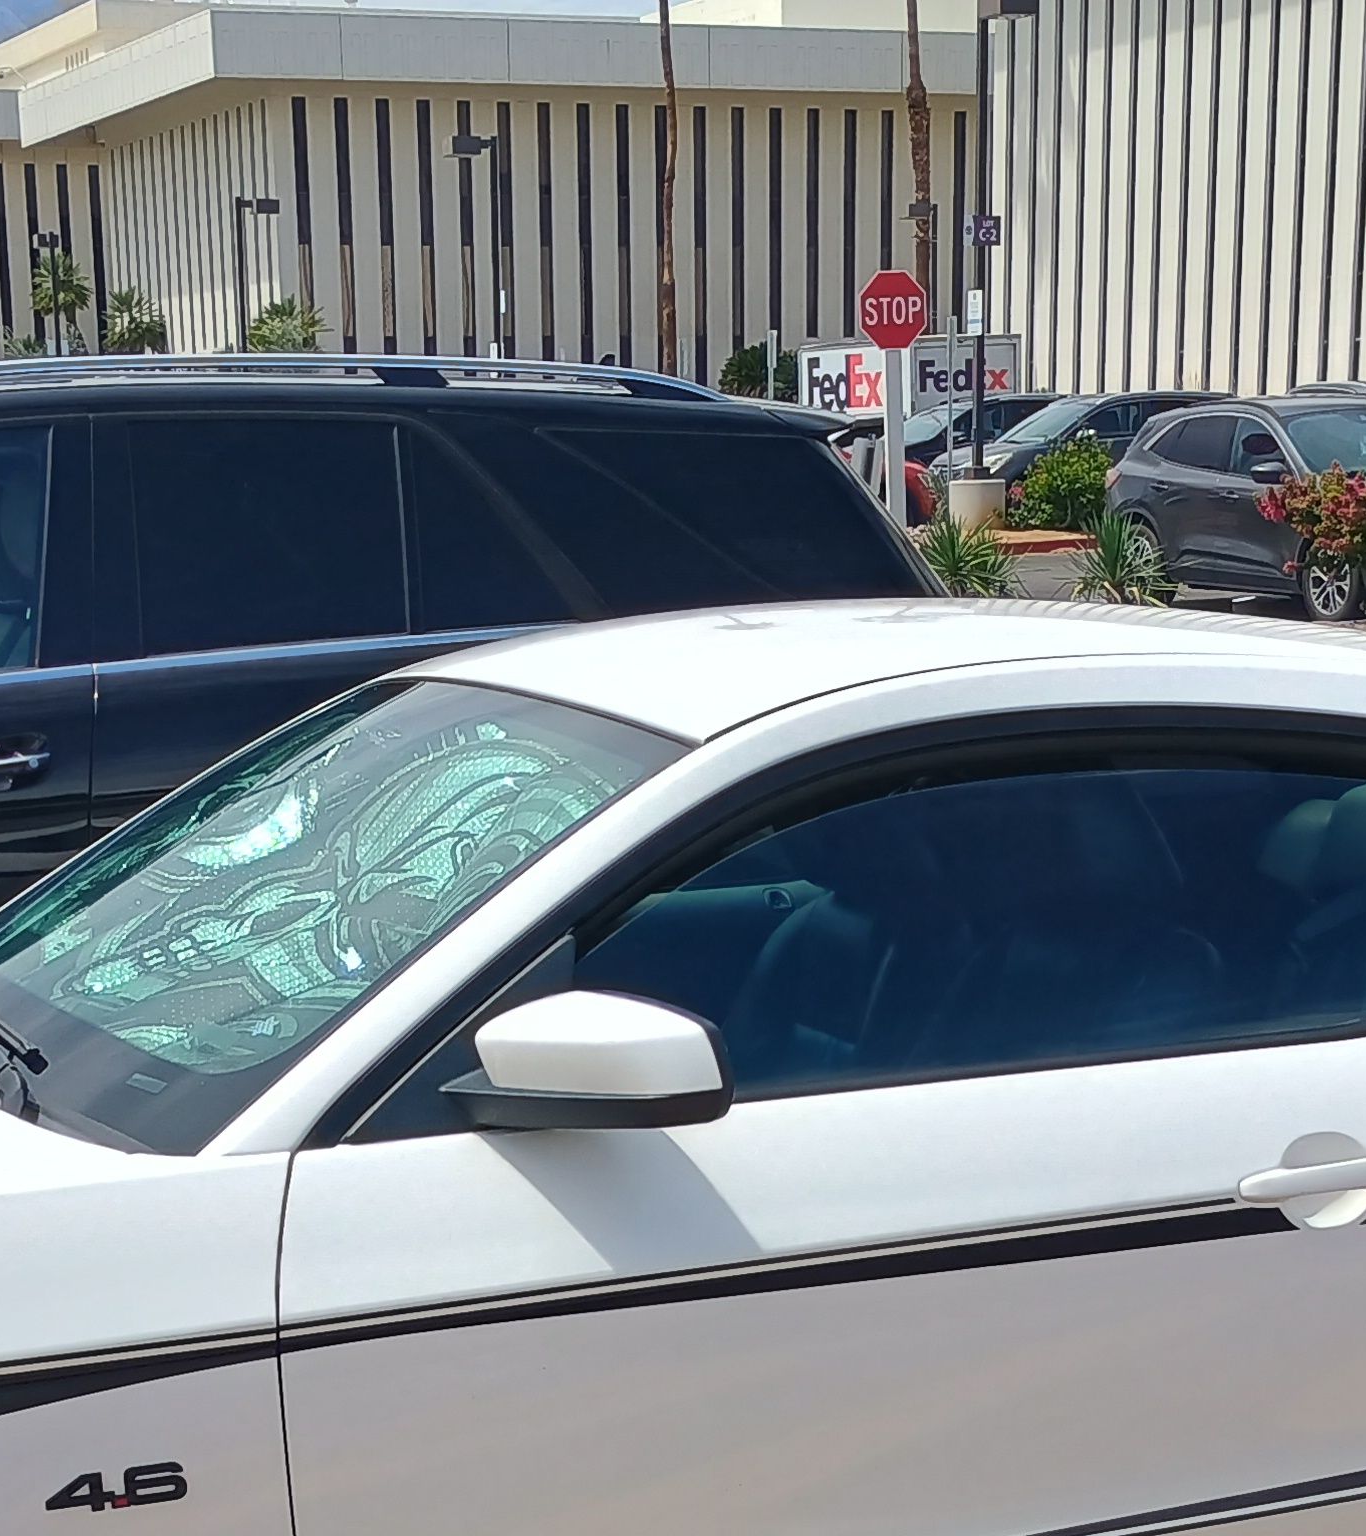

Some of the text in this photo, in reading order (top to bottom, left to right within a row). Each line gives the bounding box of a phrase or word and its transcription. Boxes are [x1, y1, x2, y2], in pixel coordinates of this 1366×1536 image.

[978, 228, 997, 242] C-2
[864, 296, 922, 326] STOP
[807, 353, 883, 411] FedEx
[918, 358, 1009, 393] Fedx
[45, 1461, 188, 1512] 4.6
